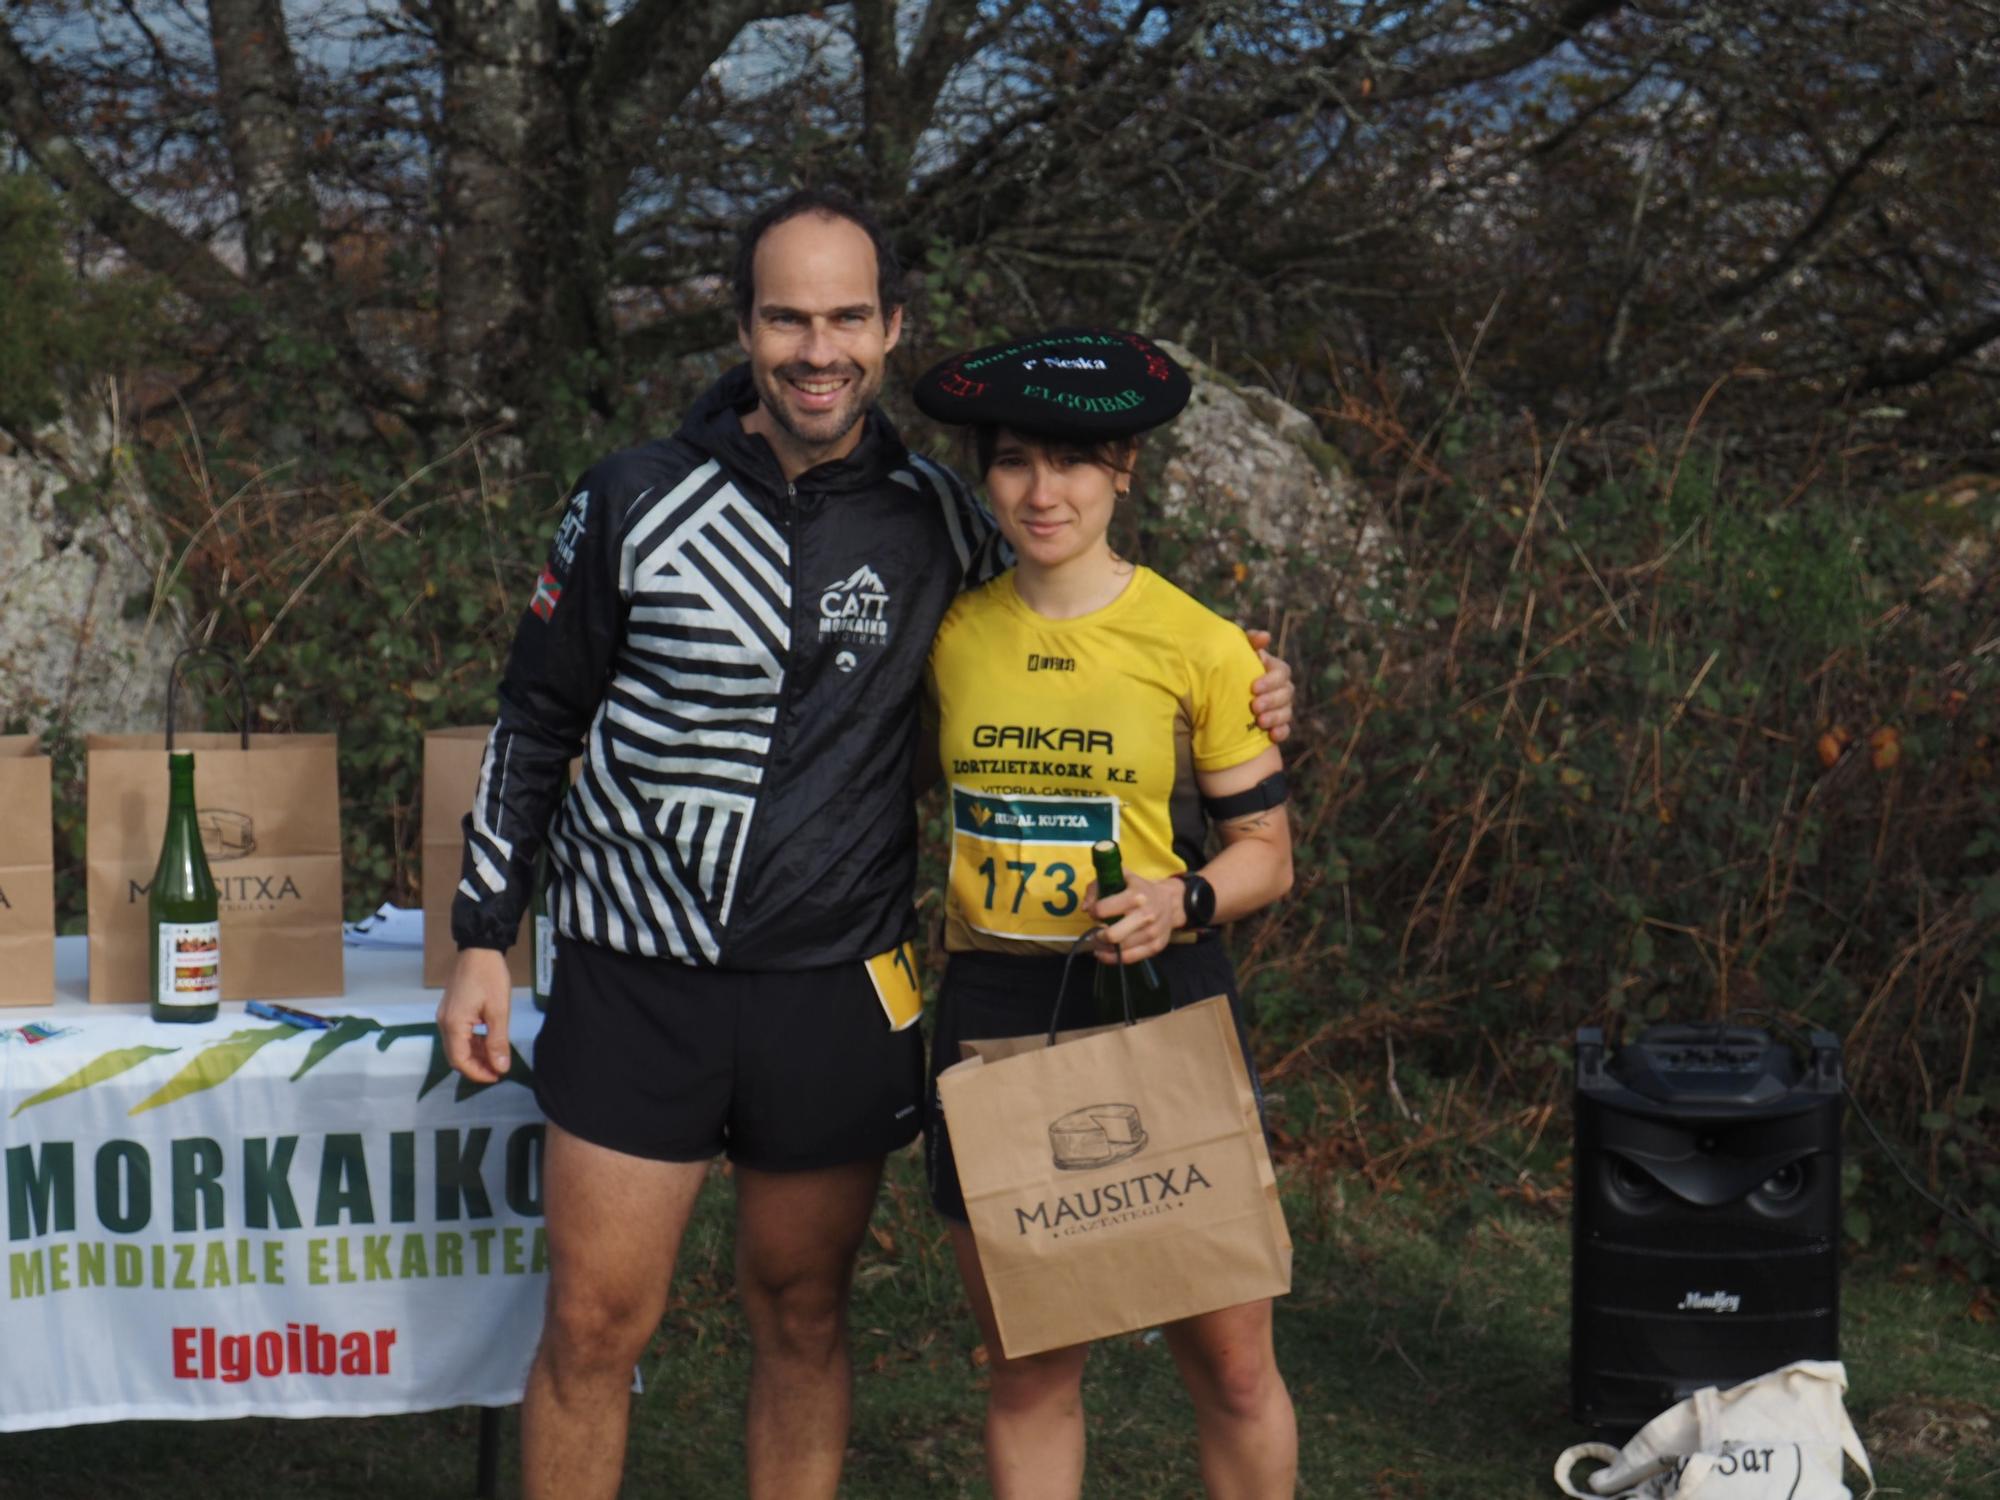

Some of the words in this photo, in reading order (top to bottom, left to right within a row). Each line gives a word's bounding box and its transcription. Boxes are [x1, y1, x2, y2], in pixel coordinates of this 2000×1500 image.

[1044, 355, 1108, 371] Neska
[1022, 383, 1146, 413] ELGOIBAR
[820, 591, 890, 620] CATT
[972, 724, 1114, 755] GAIKAR
[953, 759, 1095, 780] ZORTZIETAKOAK
[1107, 767, 1138, 784] K.E.
[1038, 814, 1089, 828] KUTXA
[978, 856, 1080, 918] 173
[5, 1122, 547, 1241] MORKAIKO
[1014, 1163, 1212, 1236] MAUSITXA
[9, 1237, 286, 1300] MENDIZALE
[306, 1226, 551, 1286] ELKARTEA
[171, 1322, 396, 1383] Elgoibar
